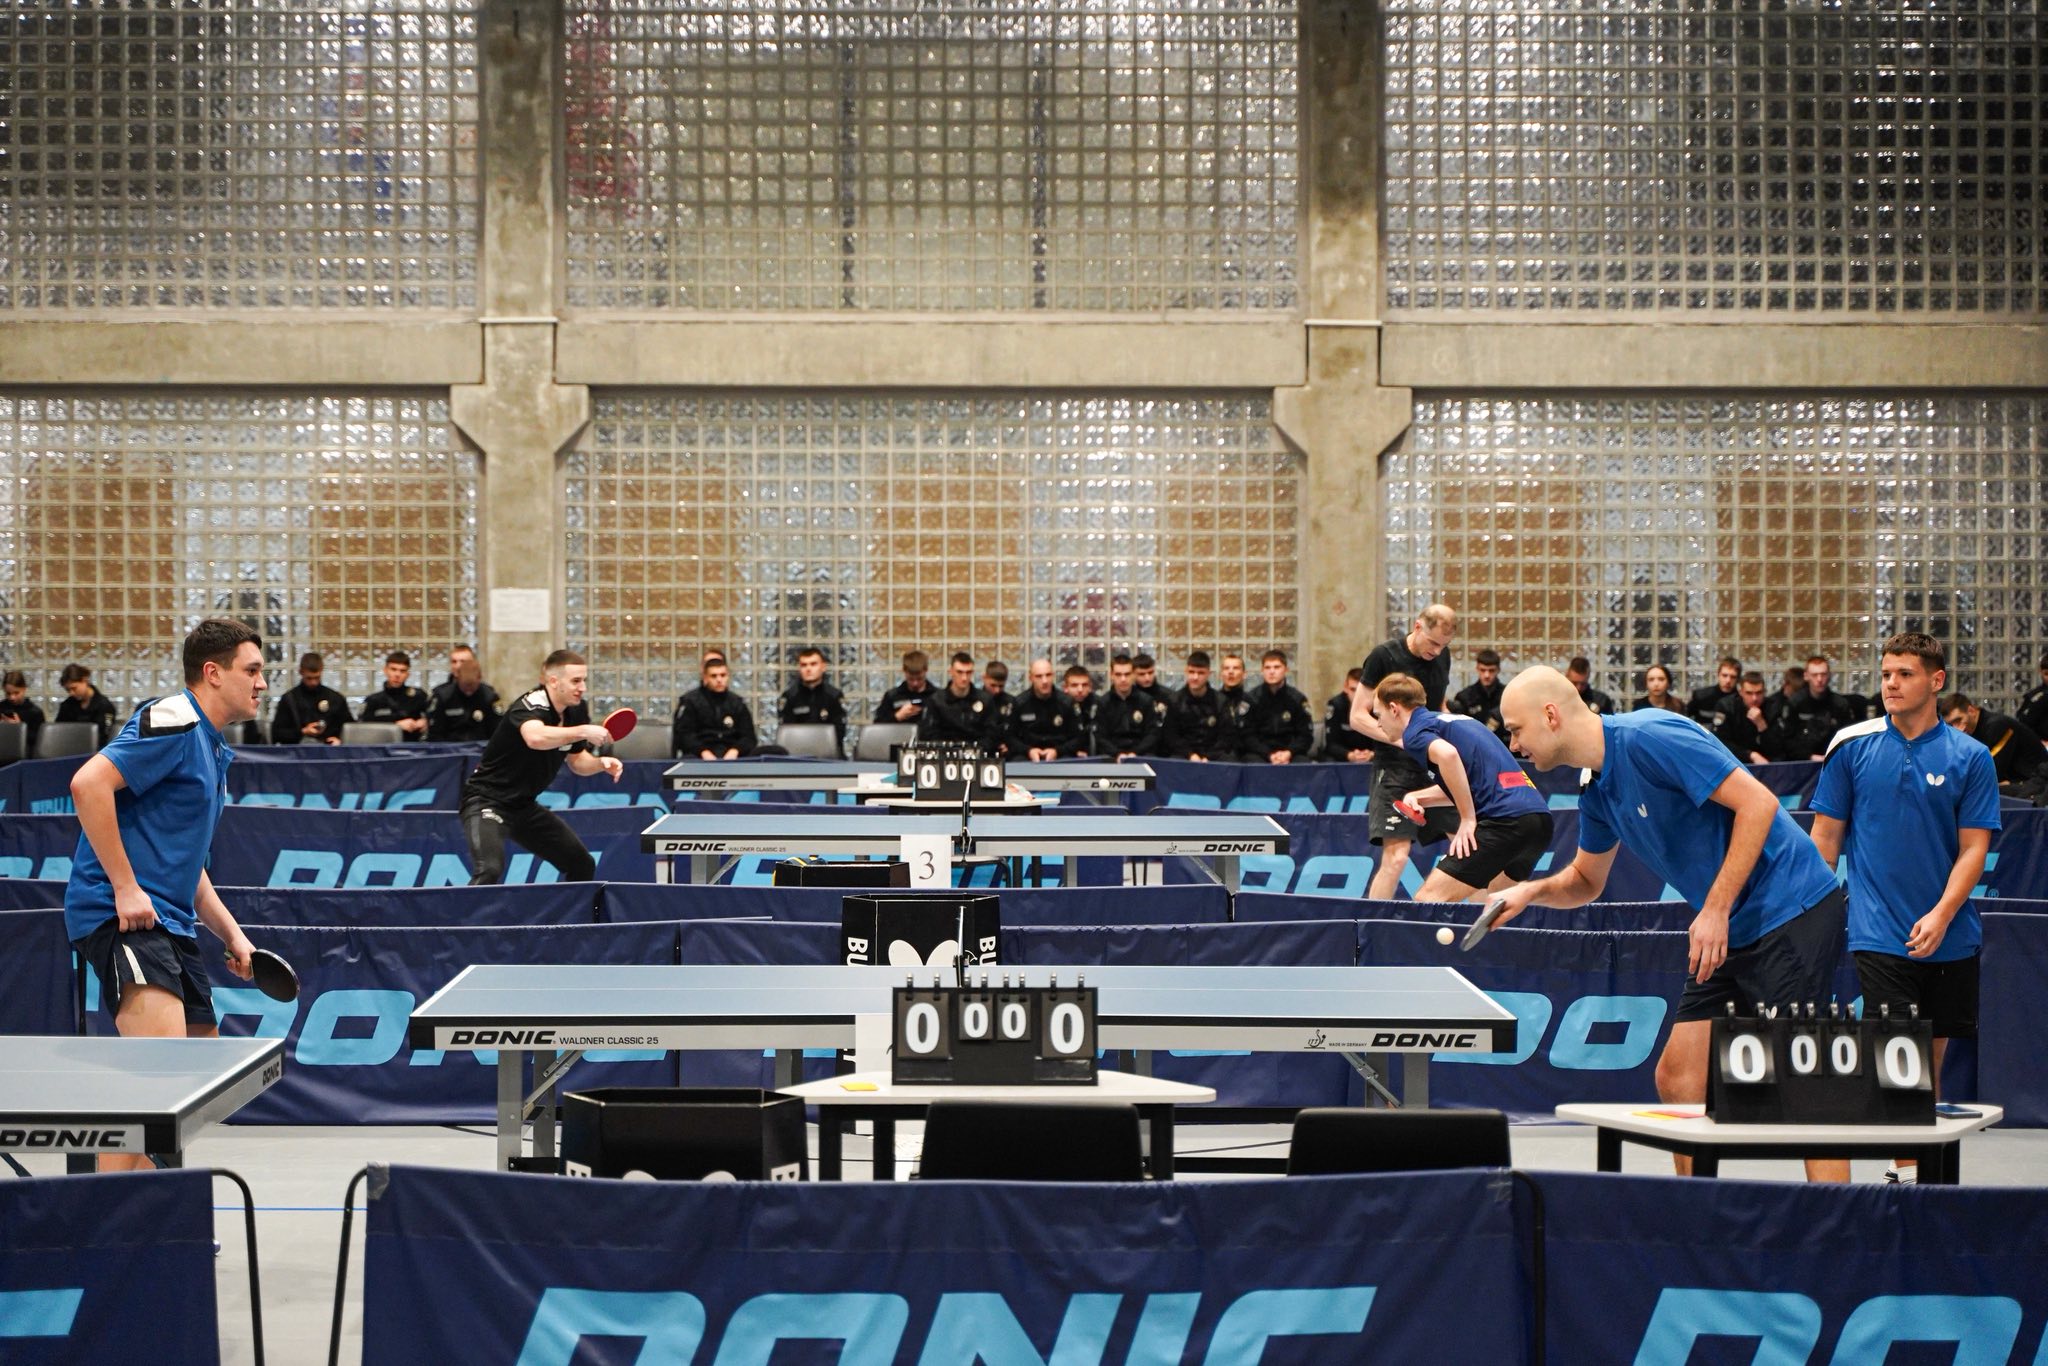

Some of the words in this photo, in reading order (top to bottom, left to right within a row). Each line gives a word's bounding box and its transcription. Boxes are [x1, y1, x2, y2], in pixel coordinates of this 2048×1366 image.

[681, 780, 728, 788] DONIC
[920, 764, 936, 788] 0
[944, 764, 957, 780] 0
[962, 764, 974, 780] 0
[984, 764, 1000, 787] 0
[1091, 781, 1137, 789] DNIC
[664, 842, 726, 851] DONIC
[1203, 844, 1266, 852] DONIC
[918, 850, 935, 880] 3
[905, 1002, 940, 1054] 0
[963, 1002, 989, 1038] 0
[1002, 1002, 1027, 1039] 0
[1050, 1002, 1085, 1054] 0
[450, 1031, 556, 1044] DONIC
[559, 1037, 605, 1045] WALDNER
[607, 1037, 644, 1045] CLASSIC
[1371, 1033, 1476, 1048] DONIC
[1728, 1034, 1766, 1082] 0
[1790, 1034, 1818, 1074] 0
[1830, 1035, 1858, 1075] 0
[1884, 1036, 1922, 1087] 0
[262, 1061, 280, 1087] DONIC
[0, 1130, 126, 1147] DONIC
